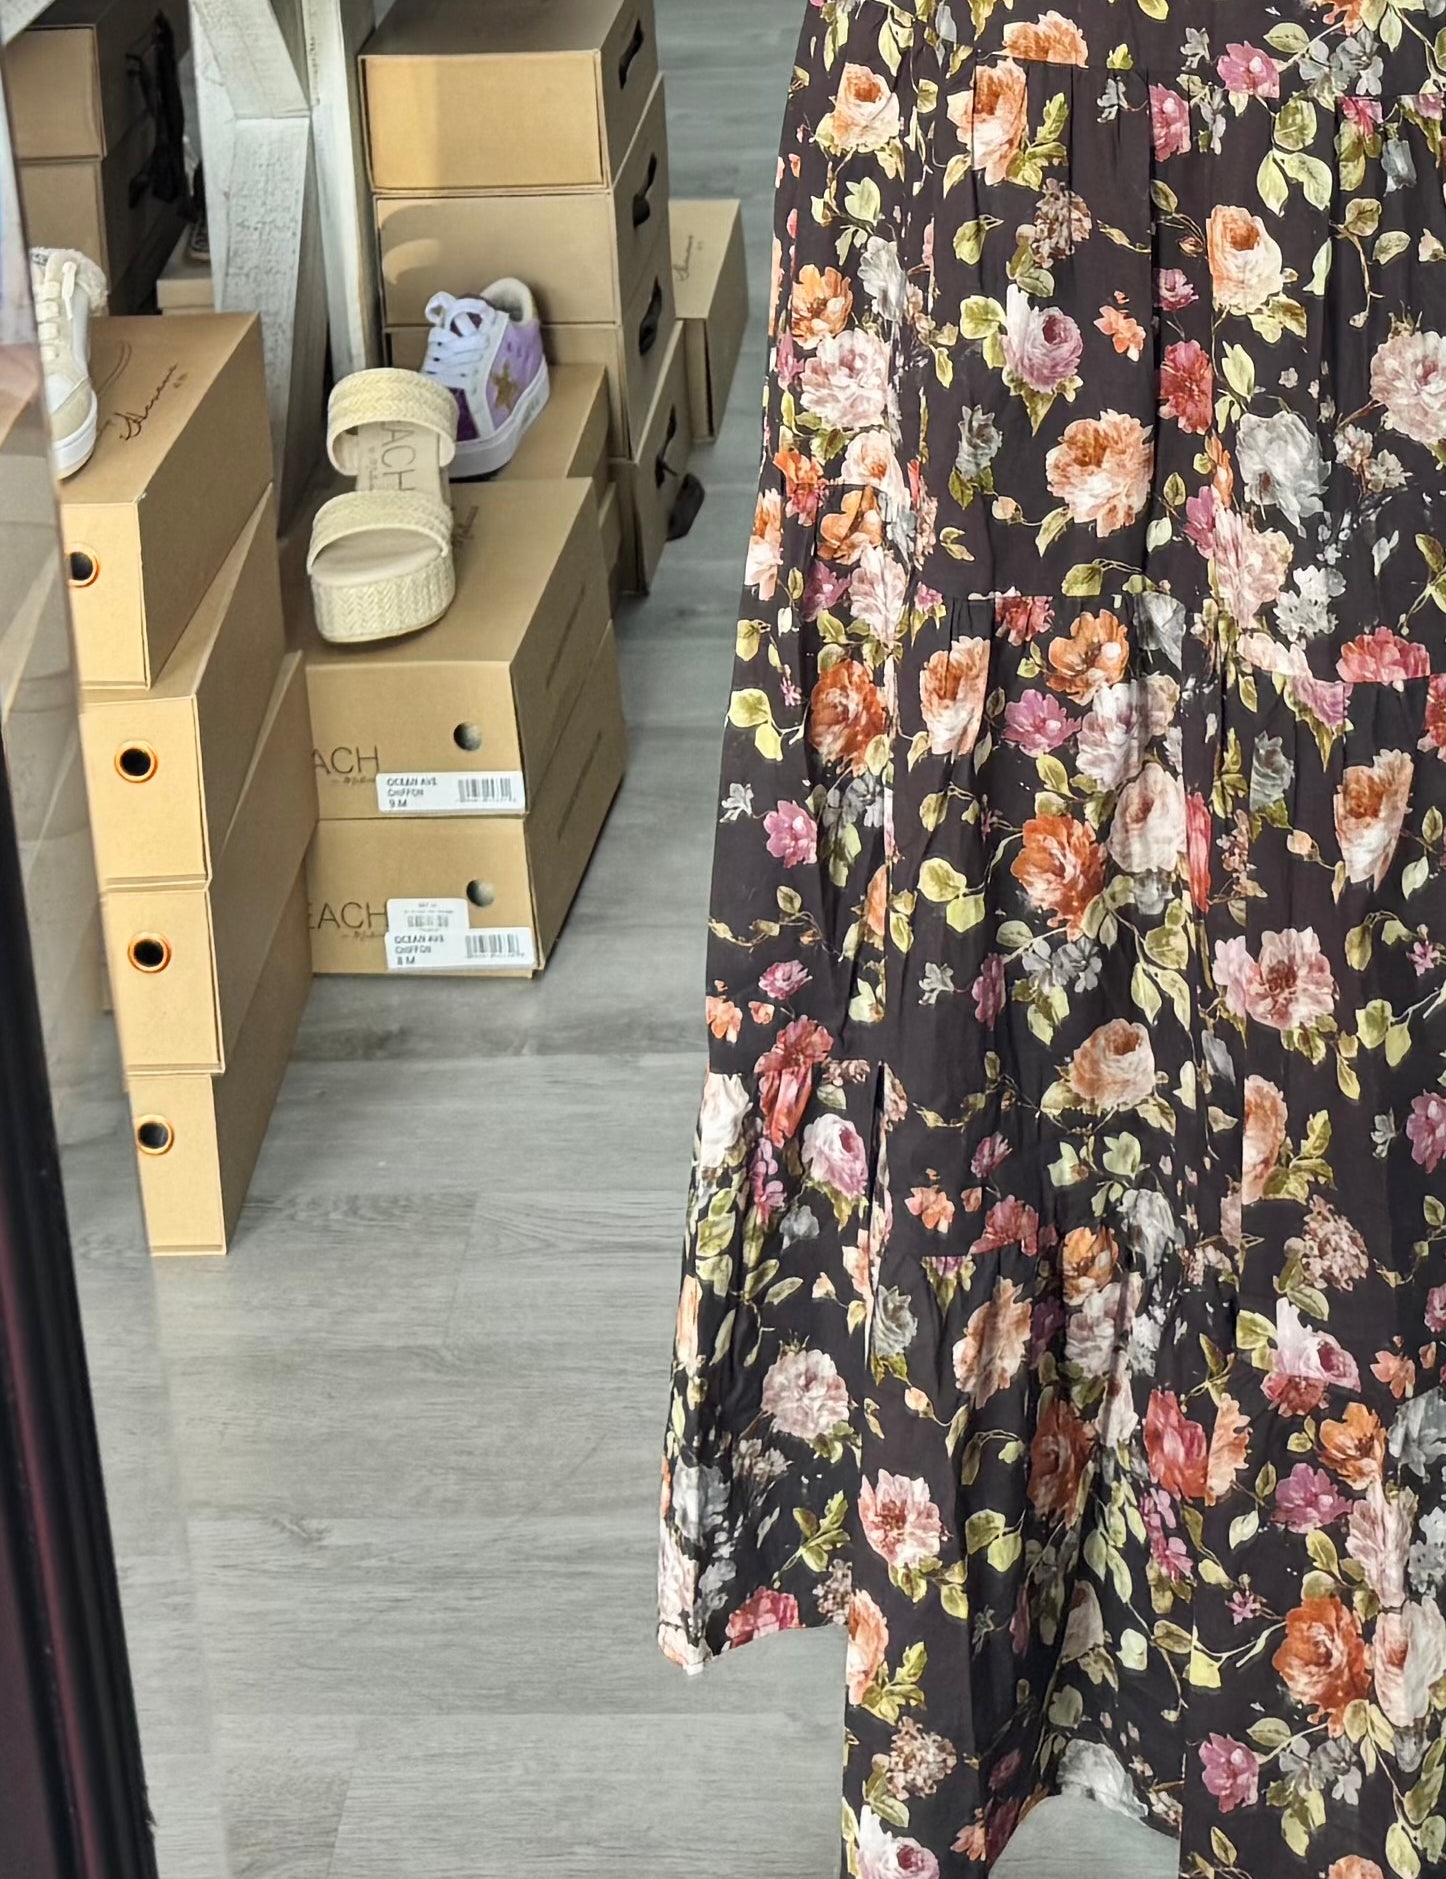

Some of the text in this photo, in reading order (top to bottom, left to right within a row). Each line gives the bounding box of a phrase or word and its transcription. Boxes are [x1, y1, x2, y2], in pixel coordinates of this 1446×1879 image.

[381, 421, 416, 491] ACH
[386, 777, 418, 787] OCEAN
[388, 799, 396, 808] 9
[394, 935, 426, 944] OCEAN
